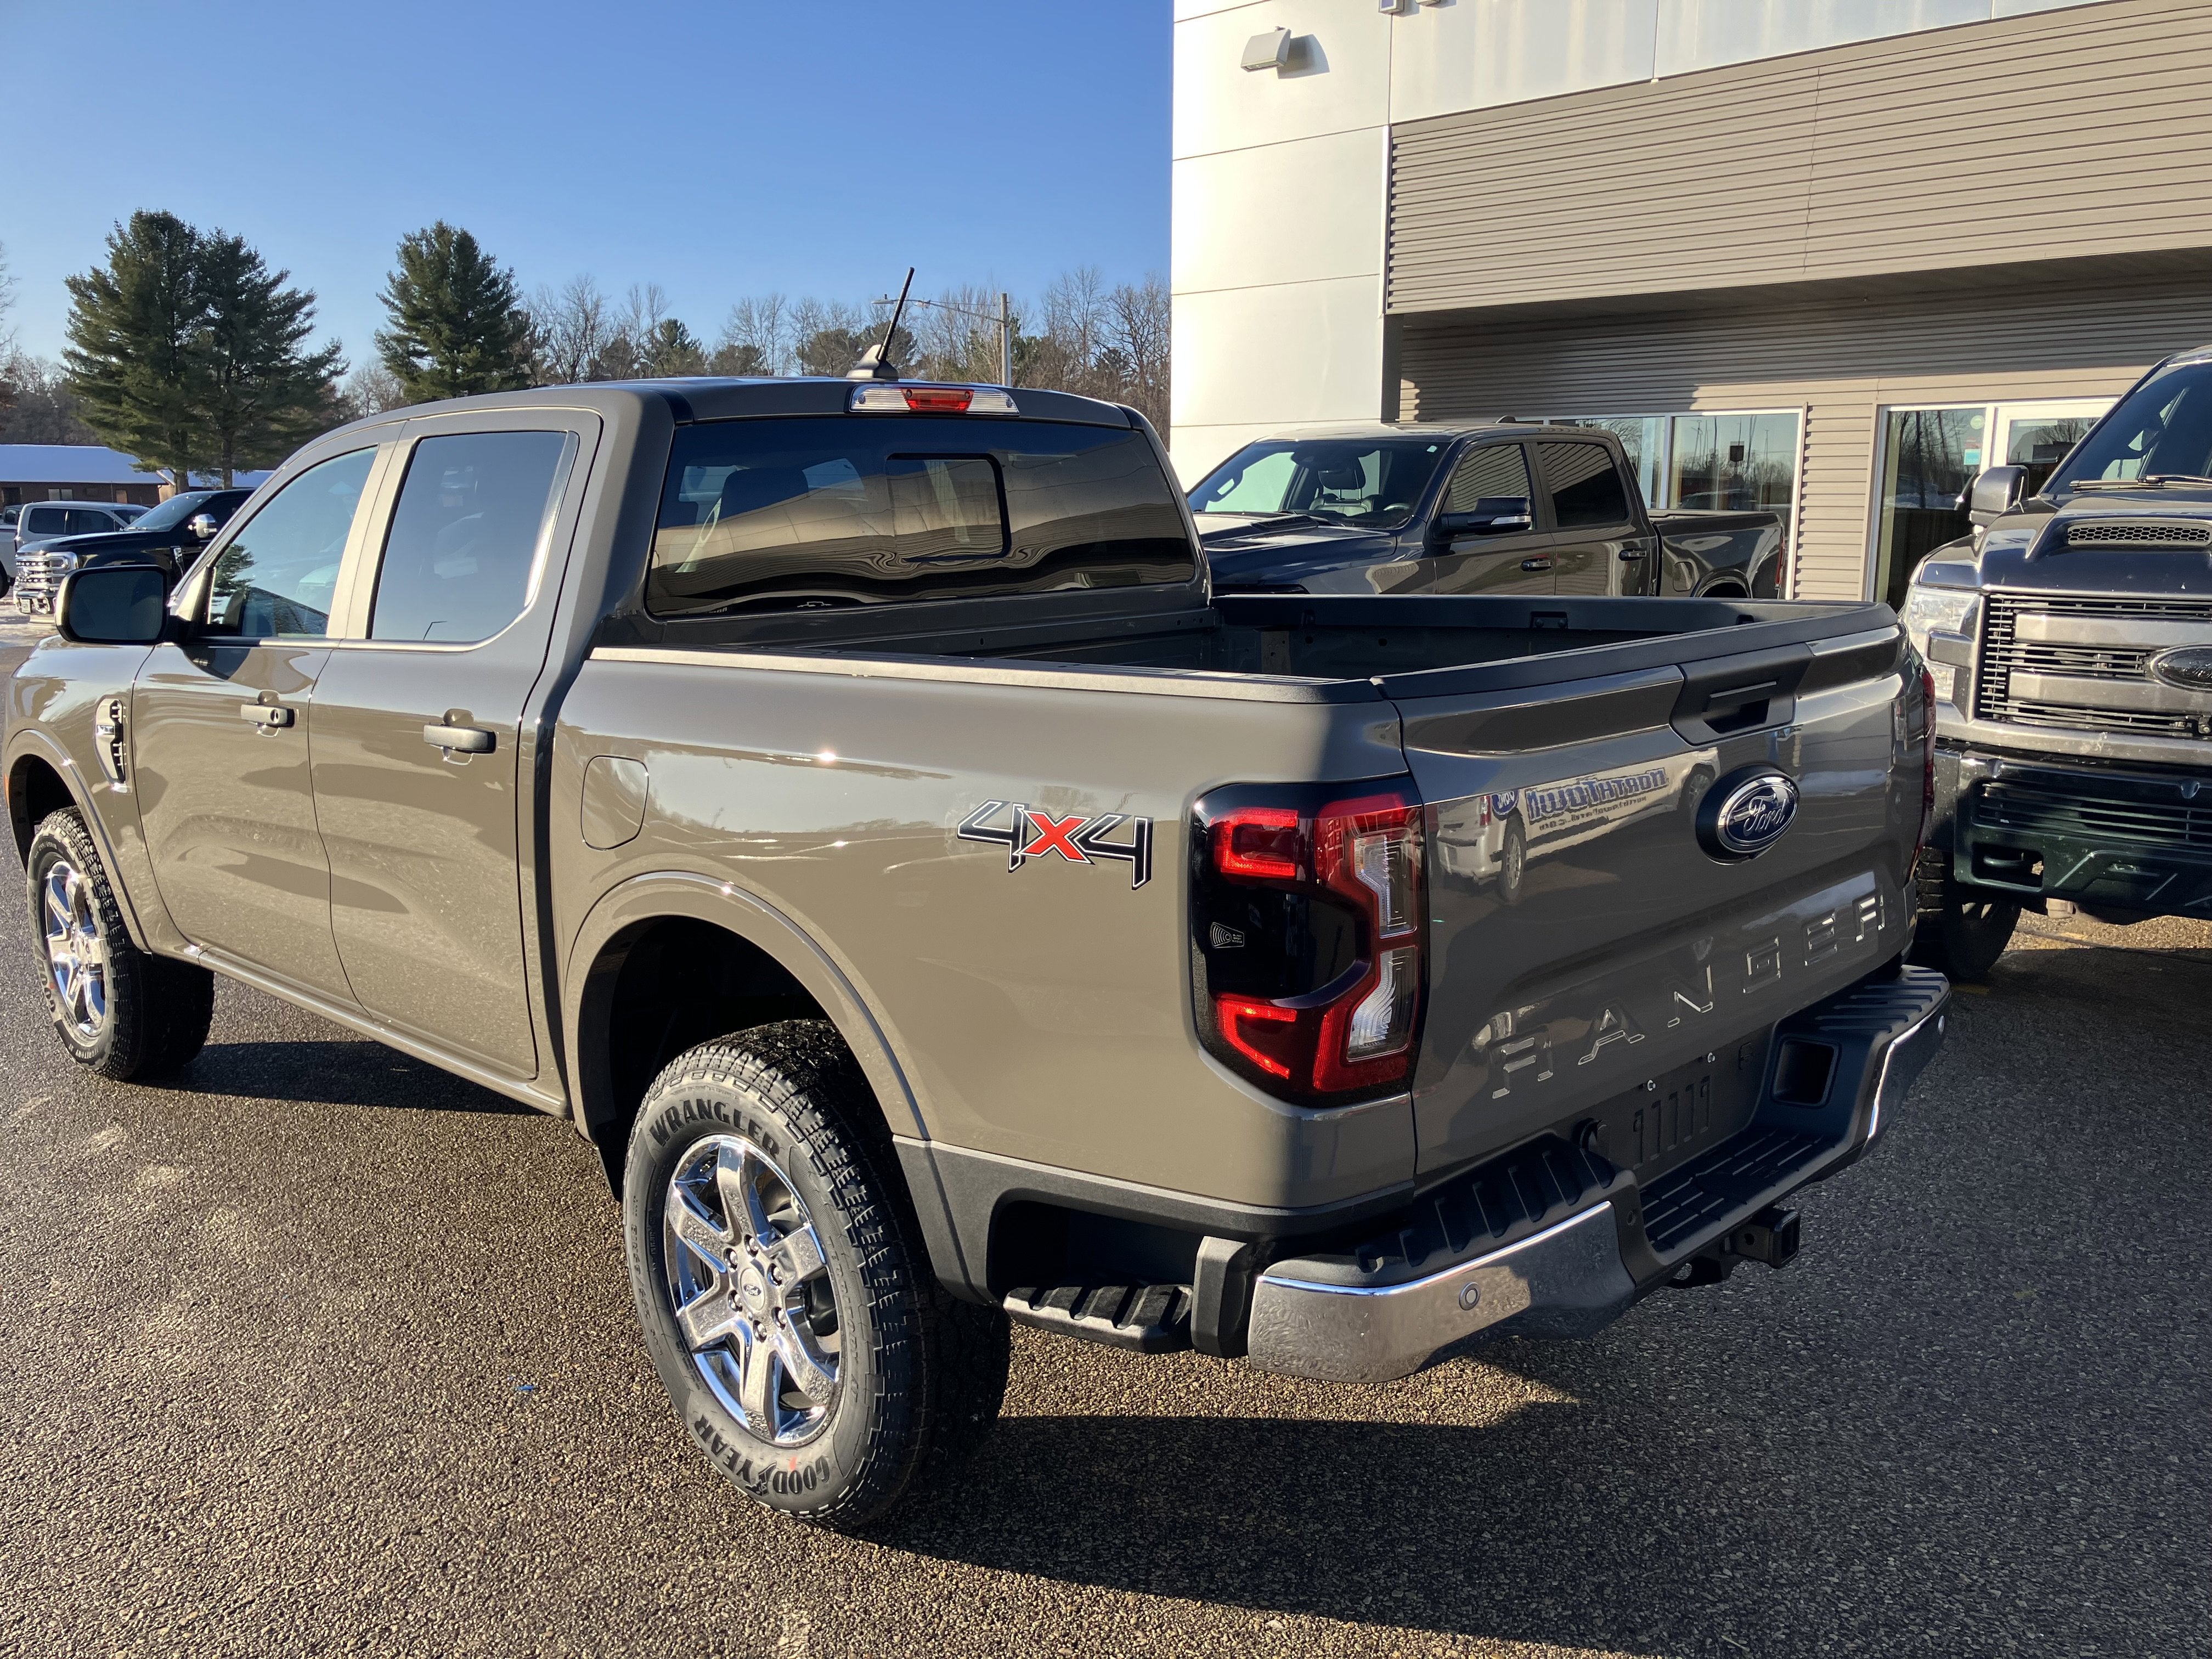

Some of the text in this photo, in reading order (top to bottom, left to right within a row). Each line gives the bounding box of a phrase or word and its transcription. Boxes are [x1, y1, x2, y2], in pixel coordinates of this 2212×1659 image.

[1743, 792, 1786, 836] Ford
[1487, 893, 1886, 1099] RANGER
[650, 1098, 780, 1161] WRANGLER
[695, 1414, 830, 1496] GOODYEAR
